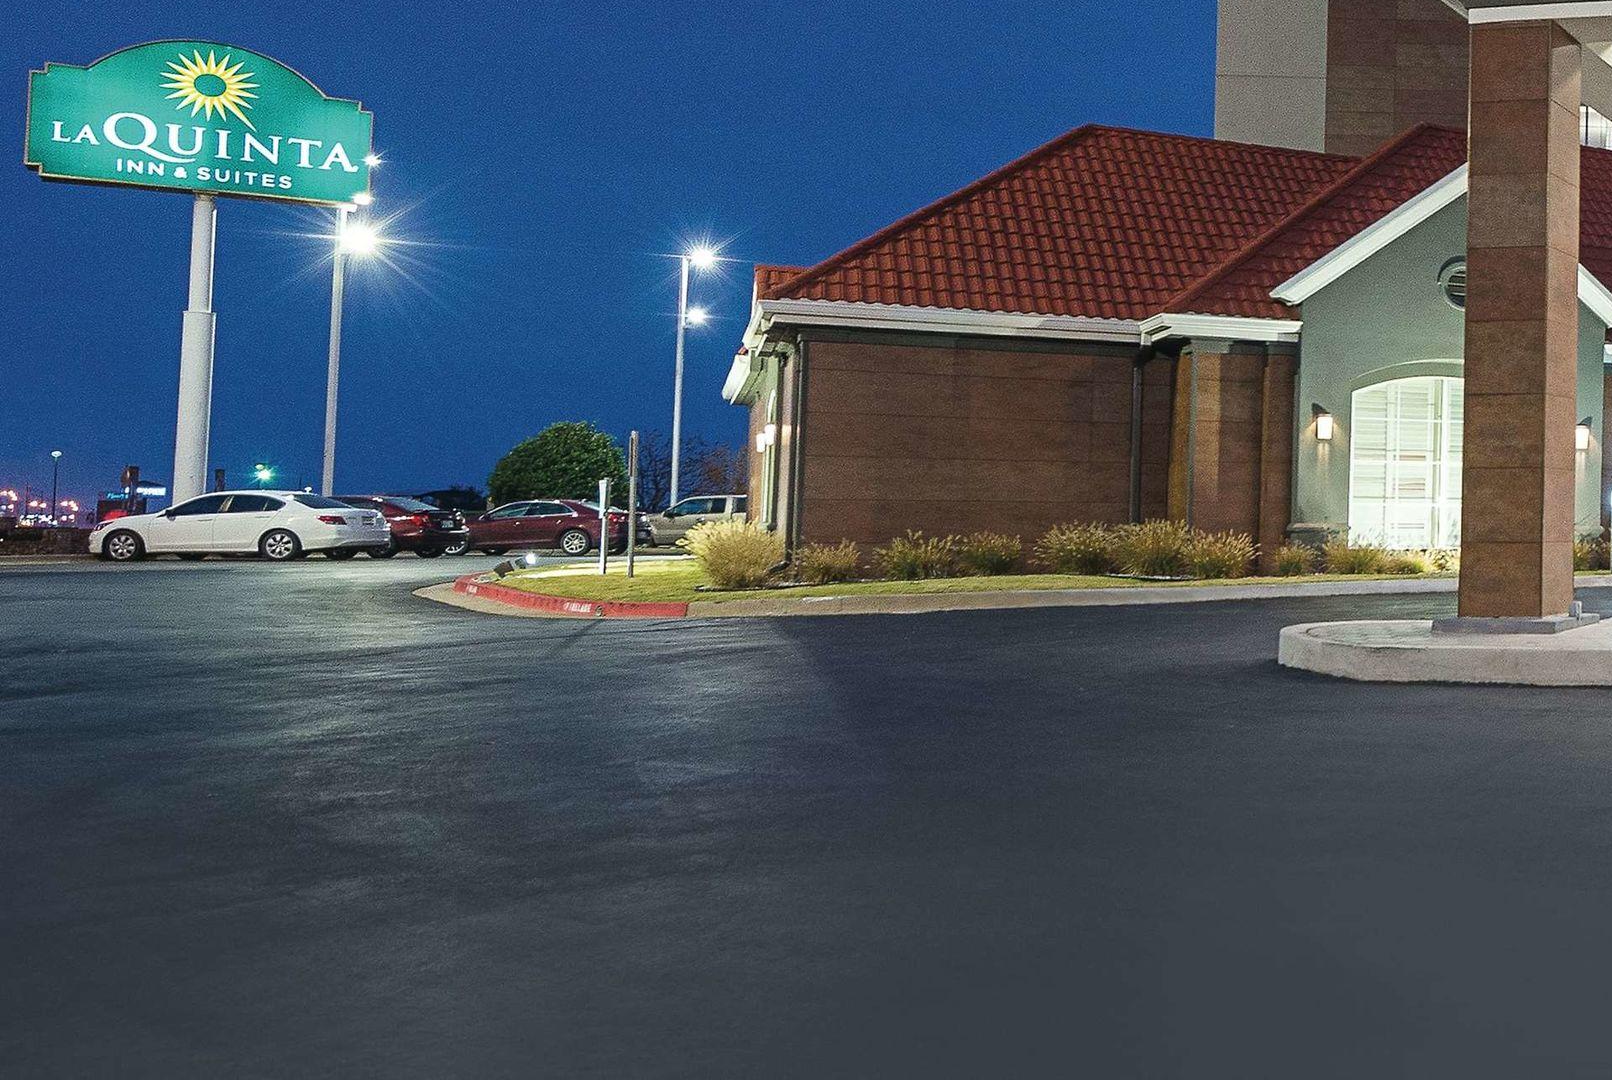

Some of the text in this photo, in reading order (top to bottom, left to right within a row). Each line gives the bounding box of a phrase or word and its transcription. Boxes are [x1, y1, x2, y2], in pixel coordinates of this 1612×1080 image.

[51, 112, 358, 173] LA QUINTA
[116, 158, 292, 190] INN & SUITES
